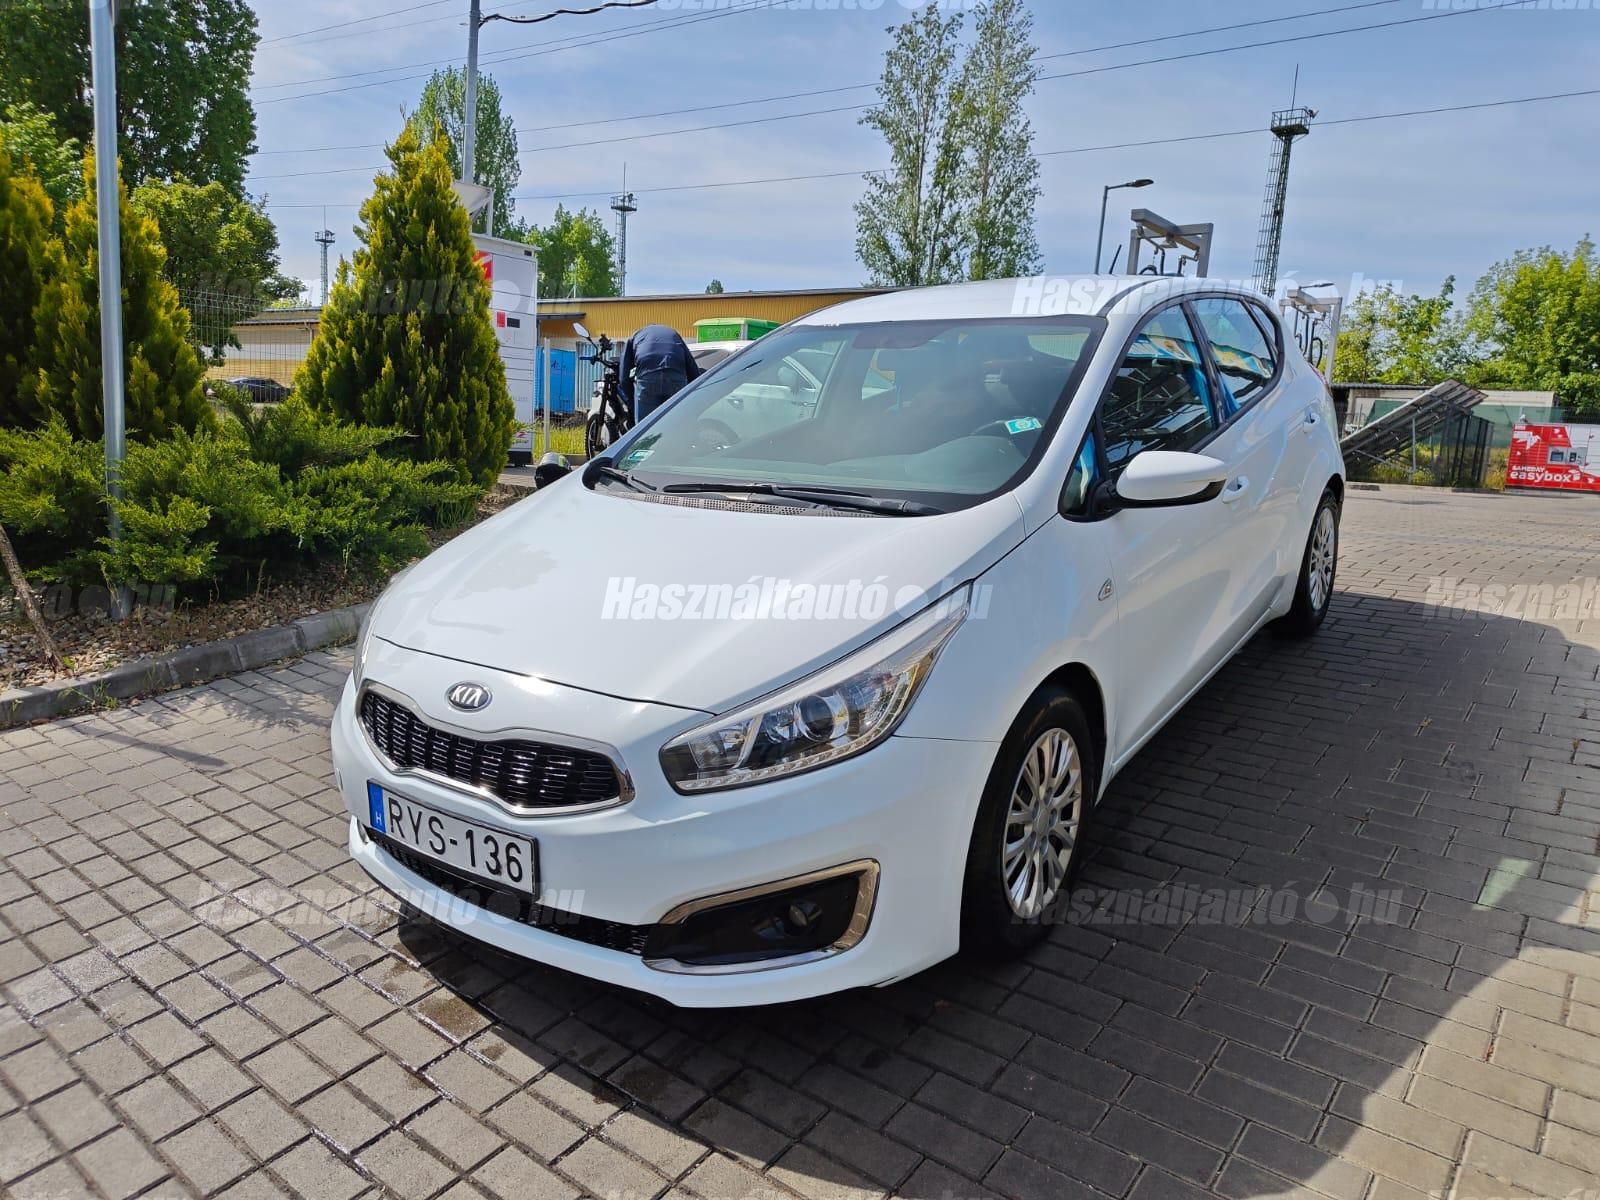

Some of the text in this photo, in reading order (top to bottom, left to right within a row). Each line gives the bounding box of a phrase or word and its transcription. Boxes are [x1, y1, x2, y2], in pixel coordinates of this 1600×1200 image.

[1510, 470, 1571, 483] easybox
[451, 686, 482, 707] KIA
[375, 797, 523, 883] H RYS-136
